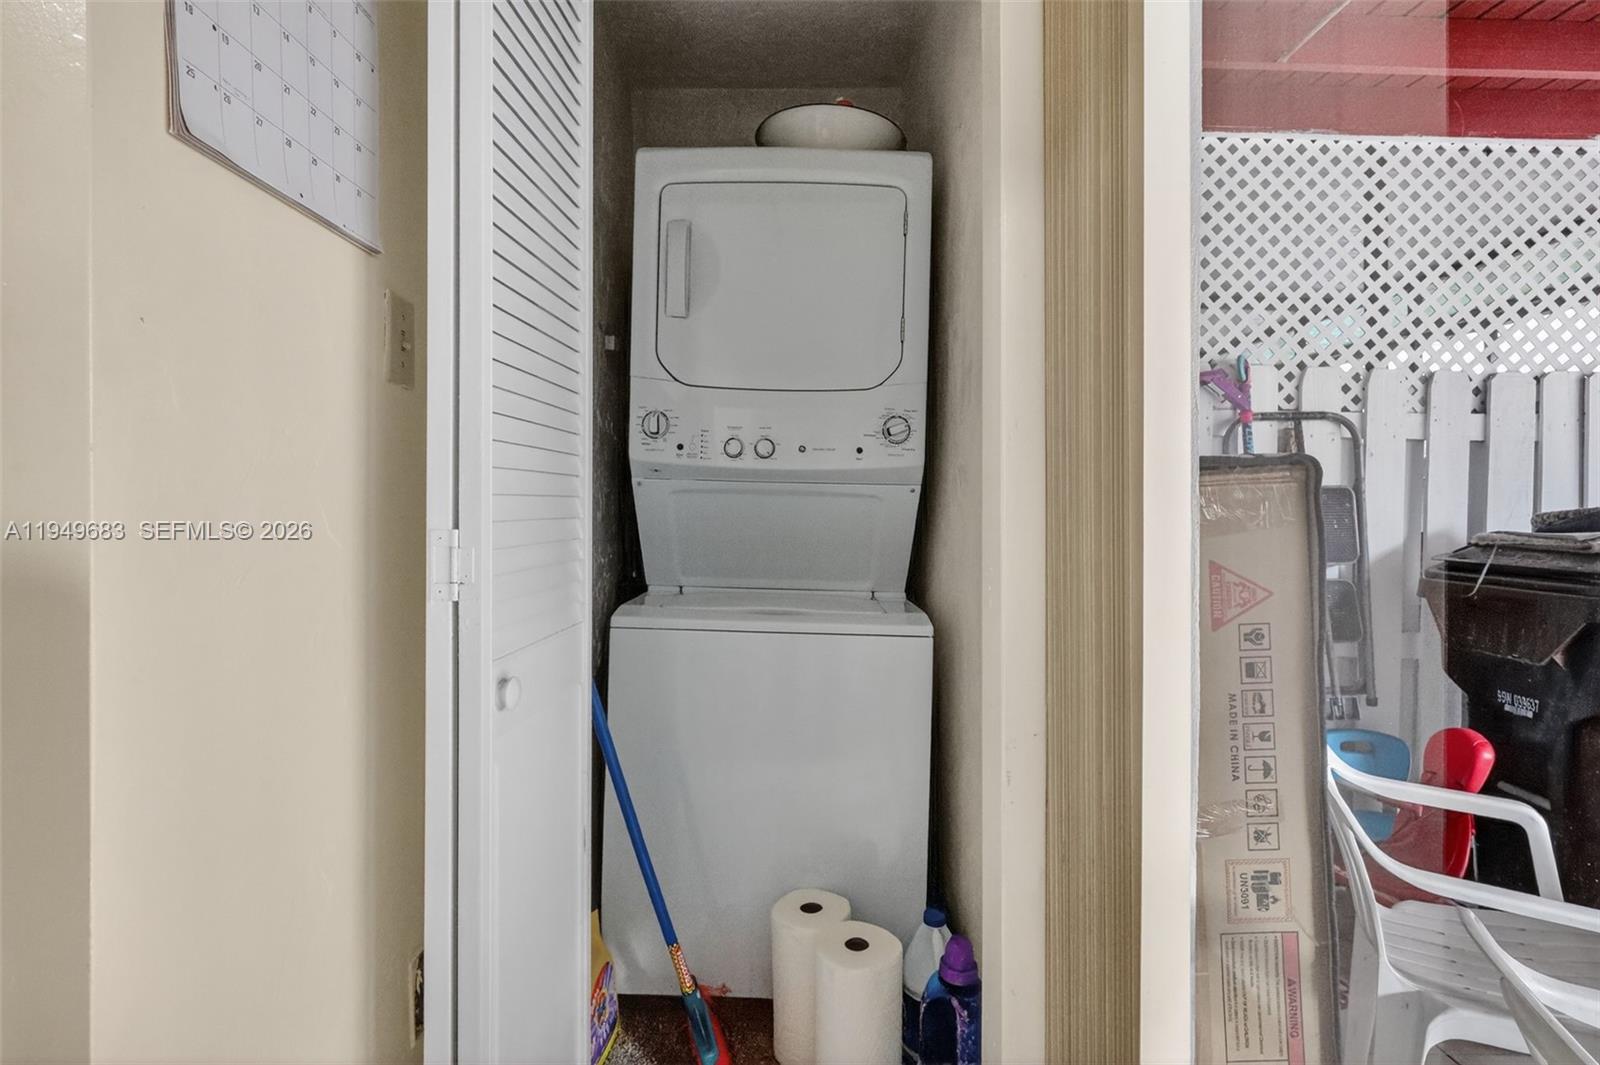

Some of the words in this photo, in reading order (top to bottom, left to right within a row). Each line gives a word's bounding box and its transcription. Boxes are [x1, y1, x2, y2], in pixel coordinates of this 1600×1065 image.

[186, 65, 195, 79] 25
[223, 92, 231, 104] 26
[1211, 574, 1222, 618] CAUTION
[1228, 693, 1238, 726] MADE
[1230, 729, 1238, 741] IN
[1230, 745, 1240, 782] CHINA
[1239, 872, 1249, 910] UN3091
[1287, 987, 1299, 1039] WARNING
